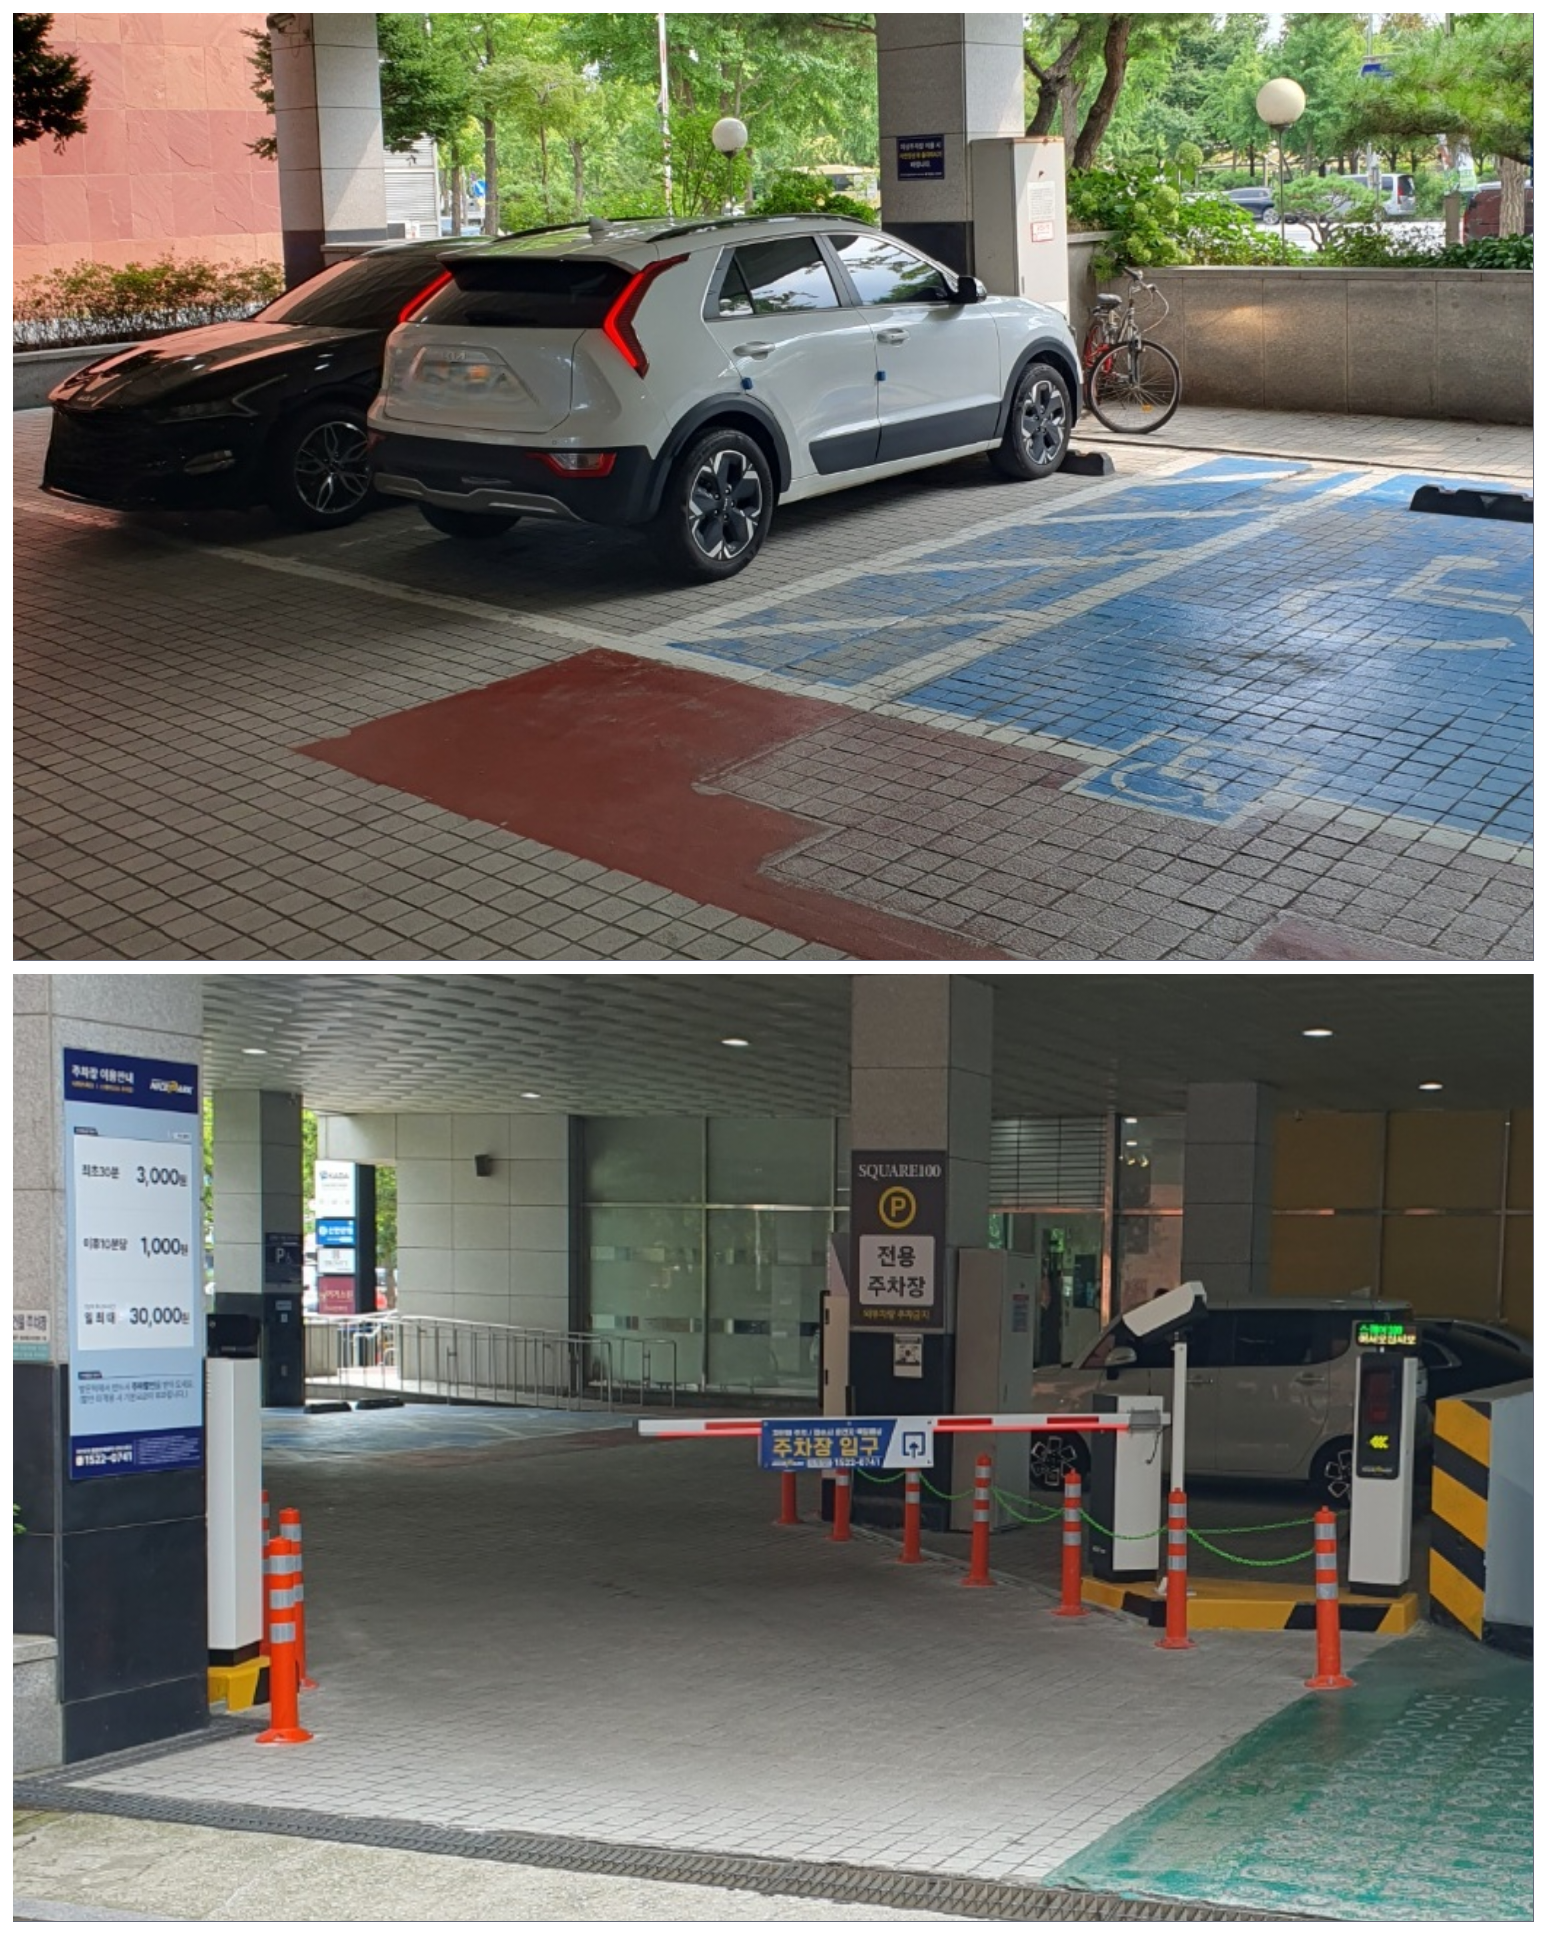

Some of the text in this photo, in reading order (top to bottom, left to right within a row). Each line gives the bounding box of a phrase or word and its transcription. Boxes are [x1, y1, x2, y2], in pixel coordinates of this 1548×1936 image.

[71, 1064, 135, 1085] 주차장 이용안내
[82, 1164, 188, 1187] 최초30분 3,000원
[858, 1163, 942, 1181] SQUARE100
[83, 1236, 189, 1258] 이후10분당 1,000원
[877, 1244, 916, 1268] 전용
[867, 1275, 926, 1298] 주차장
[129, 1307, 190, 1328] 30,000원
[773, 1436, 880, 1457] 주차장 입구
